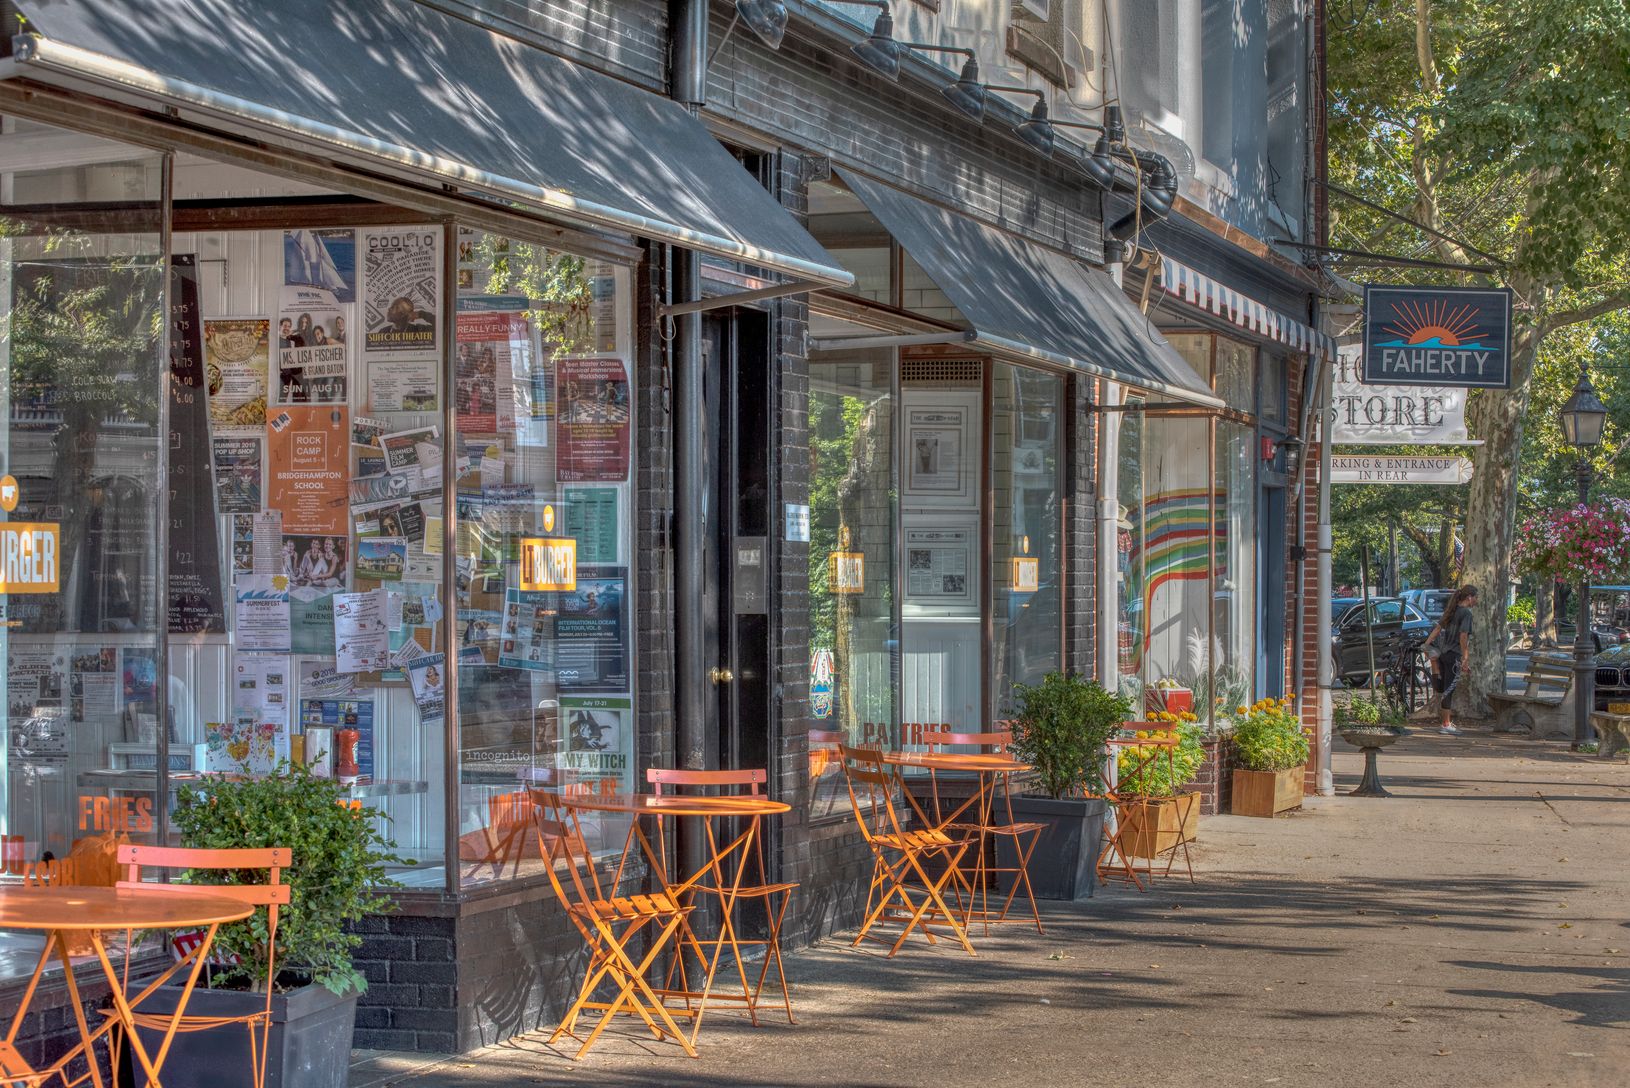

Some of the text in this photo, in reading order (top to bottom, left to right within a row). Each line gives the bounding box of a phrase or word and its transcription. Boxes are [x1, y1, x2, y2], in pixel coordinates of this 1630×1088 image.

[492, 324, 522, 332] FUNNY
[368, 332, 433, 342] SUFFOLK THEATER
[283, 348, 343, 364] MS. LISA FISCHER
[1382, 350, 1489, 374] FAHERTY
[308, 366, 326, 376] GRAND
[327, 364, 344, 375] BATON
[73, 376, 94, 386] COLE
[283, 383, 343, 393] SUN AUG 11
[297, 447, 321, 455] CAMP
[1332, 459, 1450, 469] RKING & ENTRANCE
[1360, 471, 1408, 480] IN REAR
[320, 667, 335, 677] 2019
[466, 750, 530, 763] incognito
[566, 754, 626, 768] MY WITCH
[79, 796, 152, 832] FRIES
